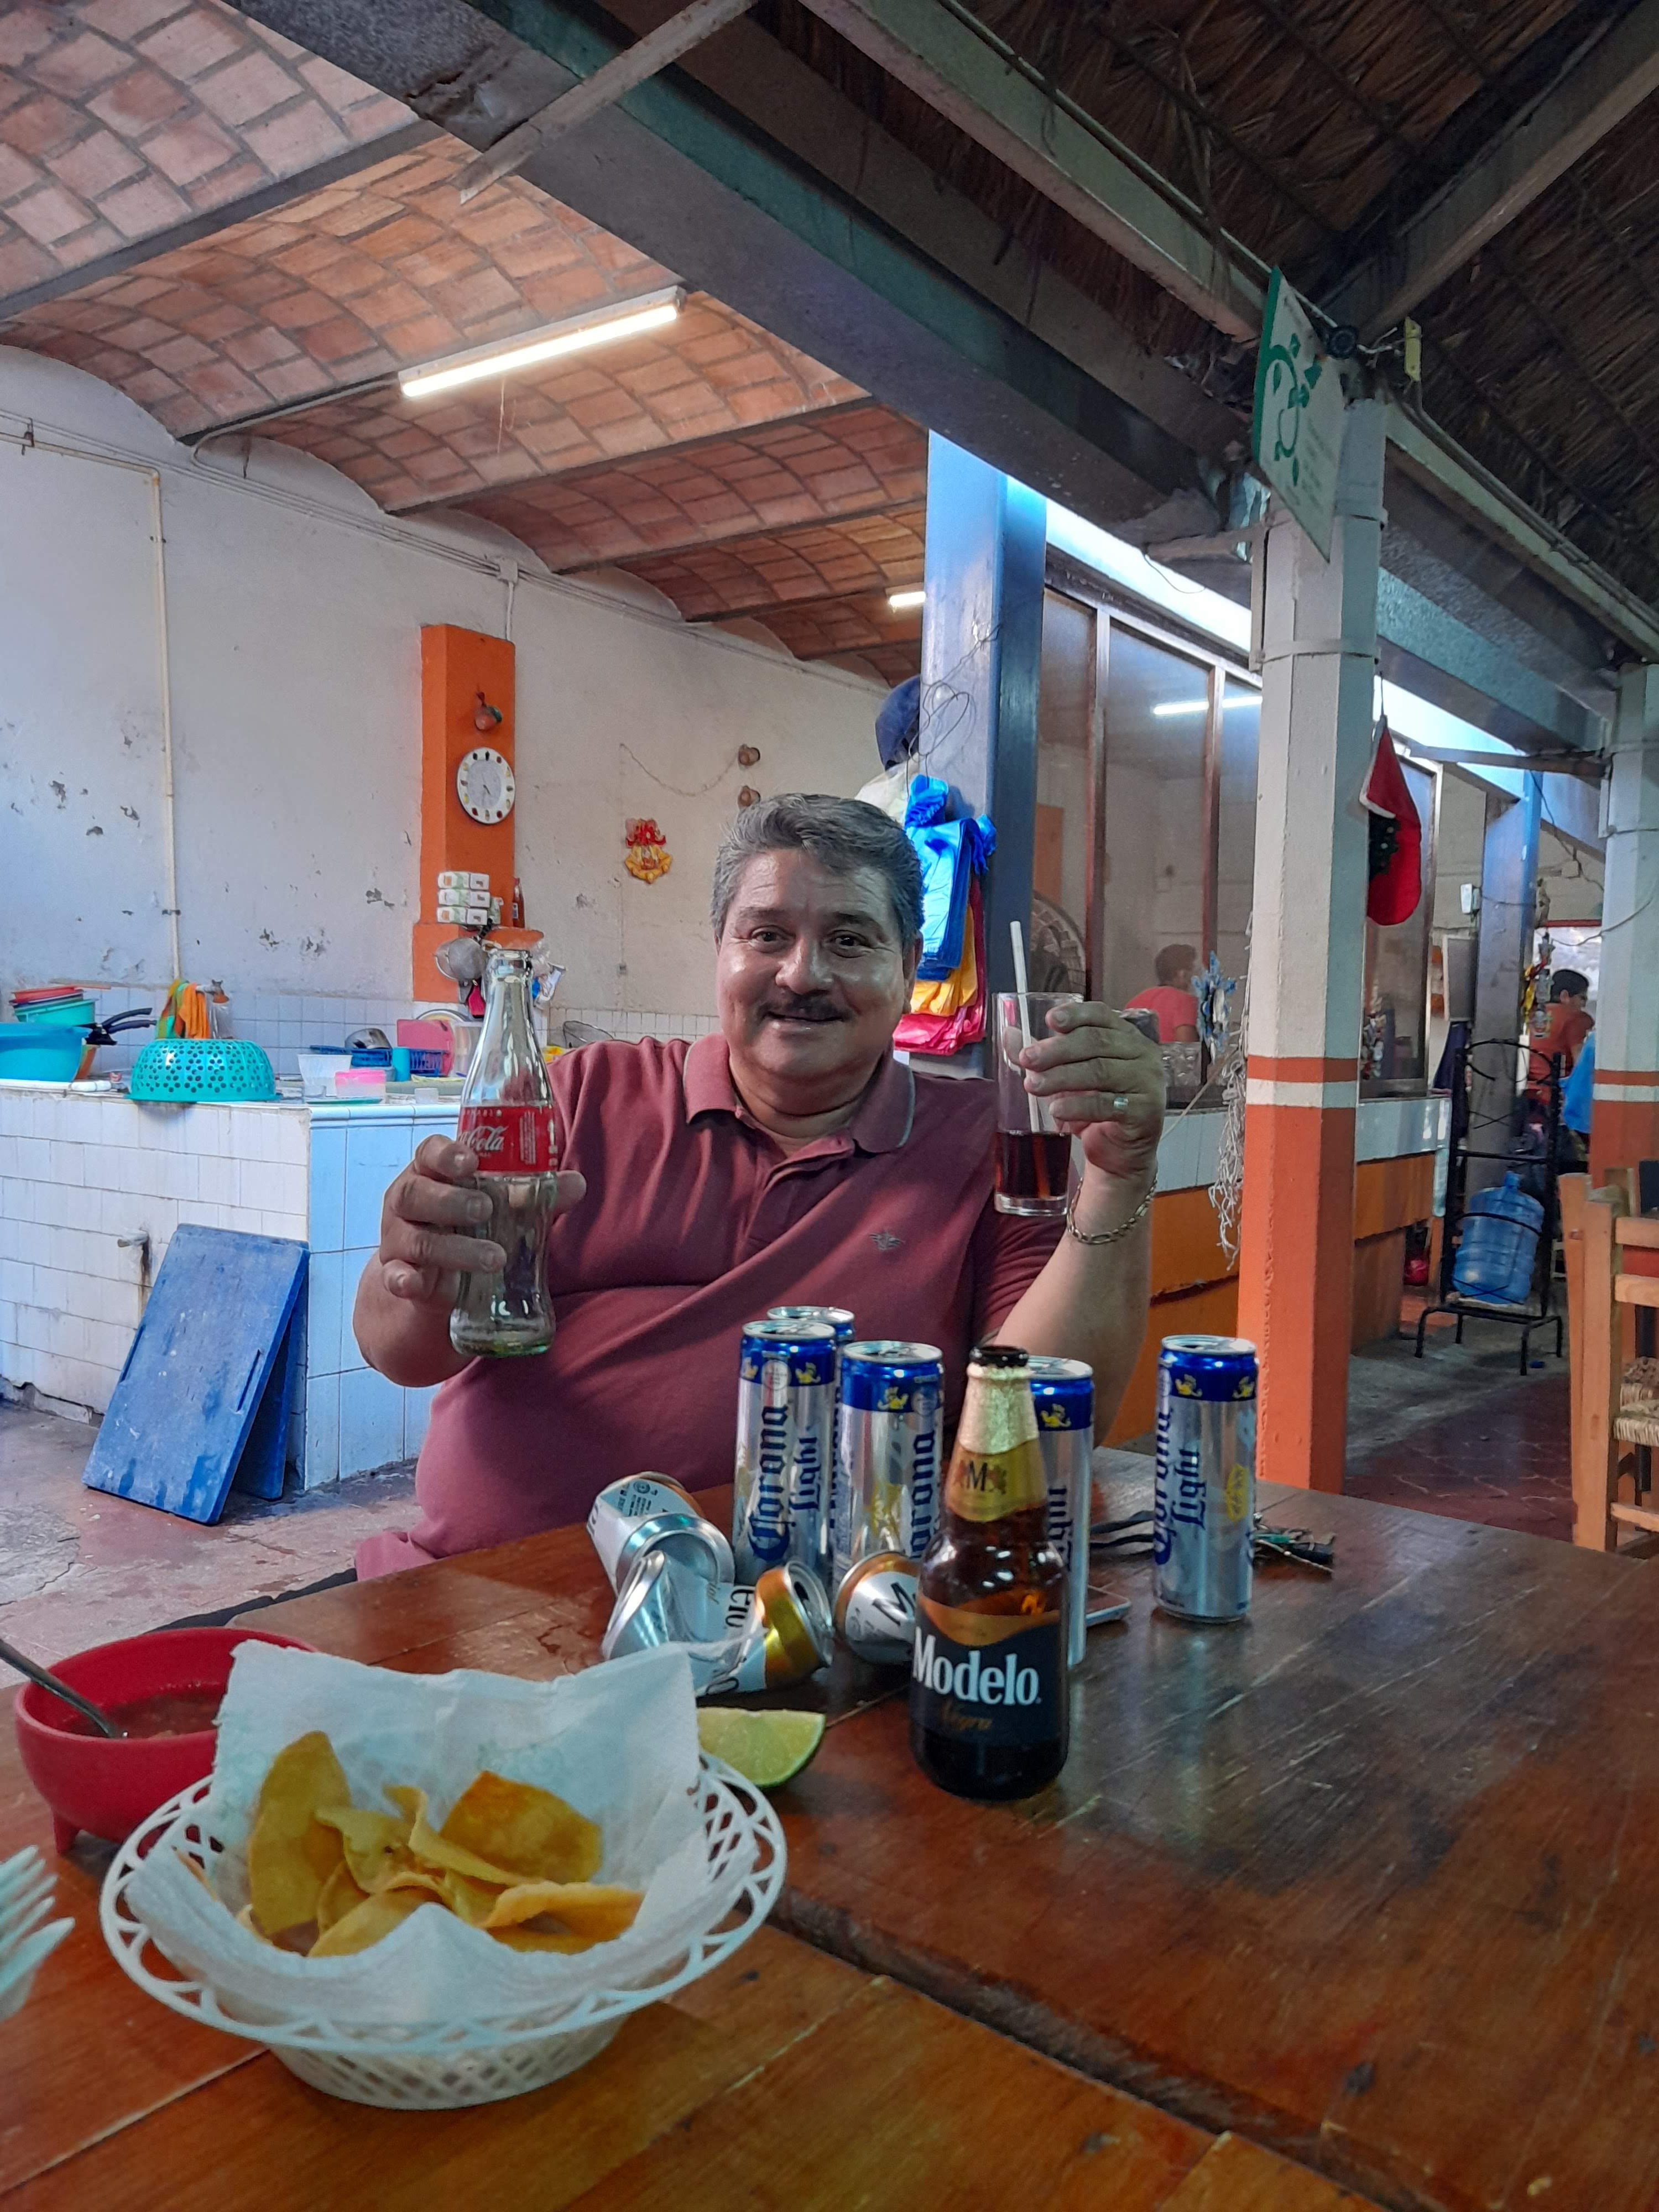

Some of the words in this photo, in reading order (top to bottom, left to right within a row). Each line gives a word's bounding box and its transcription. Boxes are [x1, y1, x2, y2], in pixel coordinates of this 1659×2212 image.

[748, 1405, 795, 1561] Corona
[789, 1436, 821, 1510] Light
[911, 1431, 935, 1558] orona
[1172, 1448, 1207, 1528] Light
[912, 1626, 1040, 1705] Modelo
